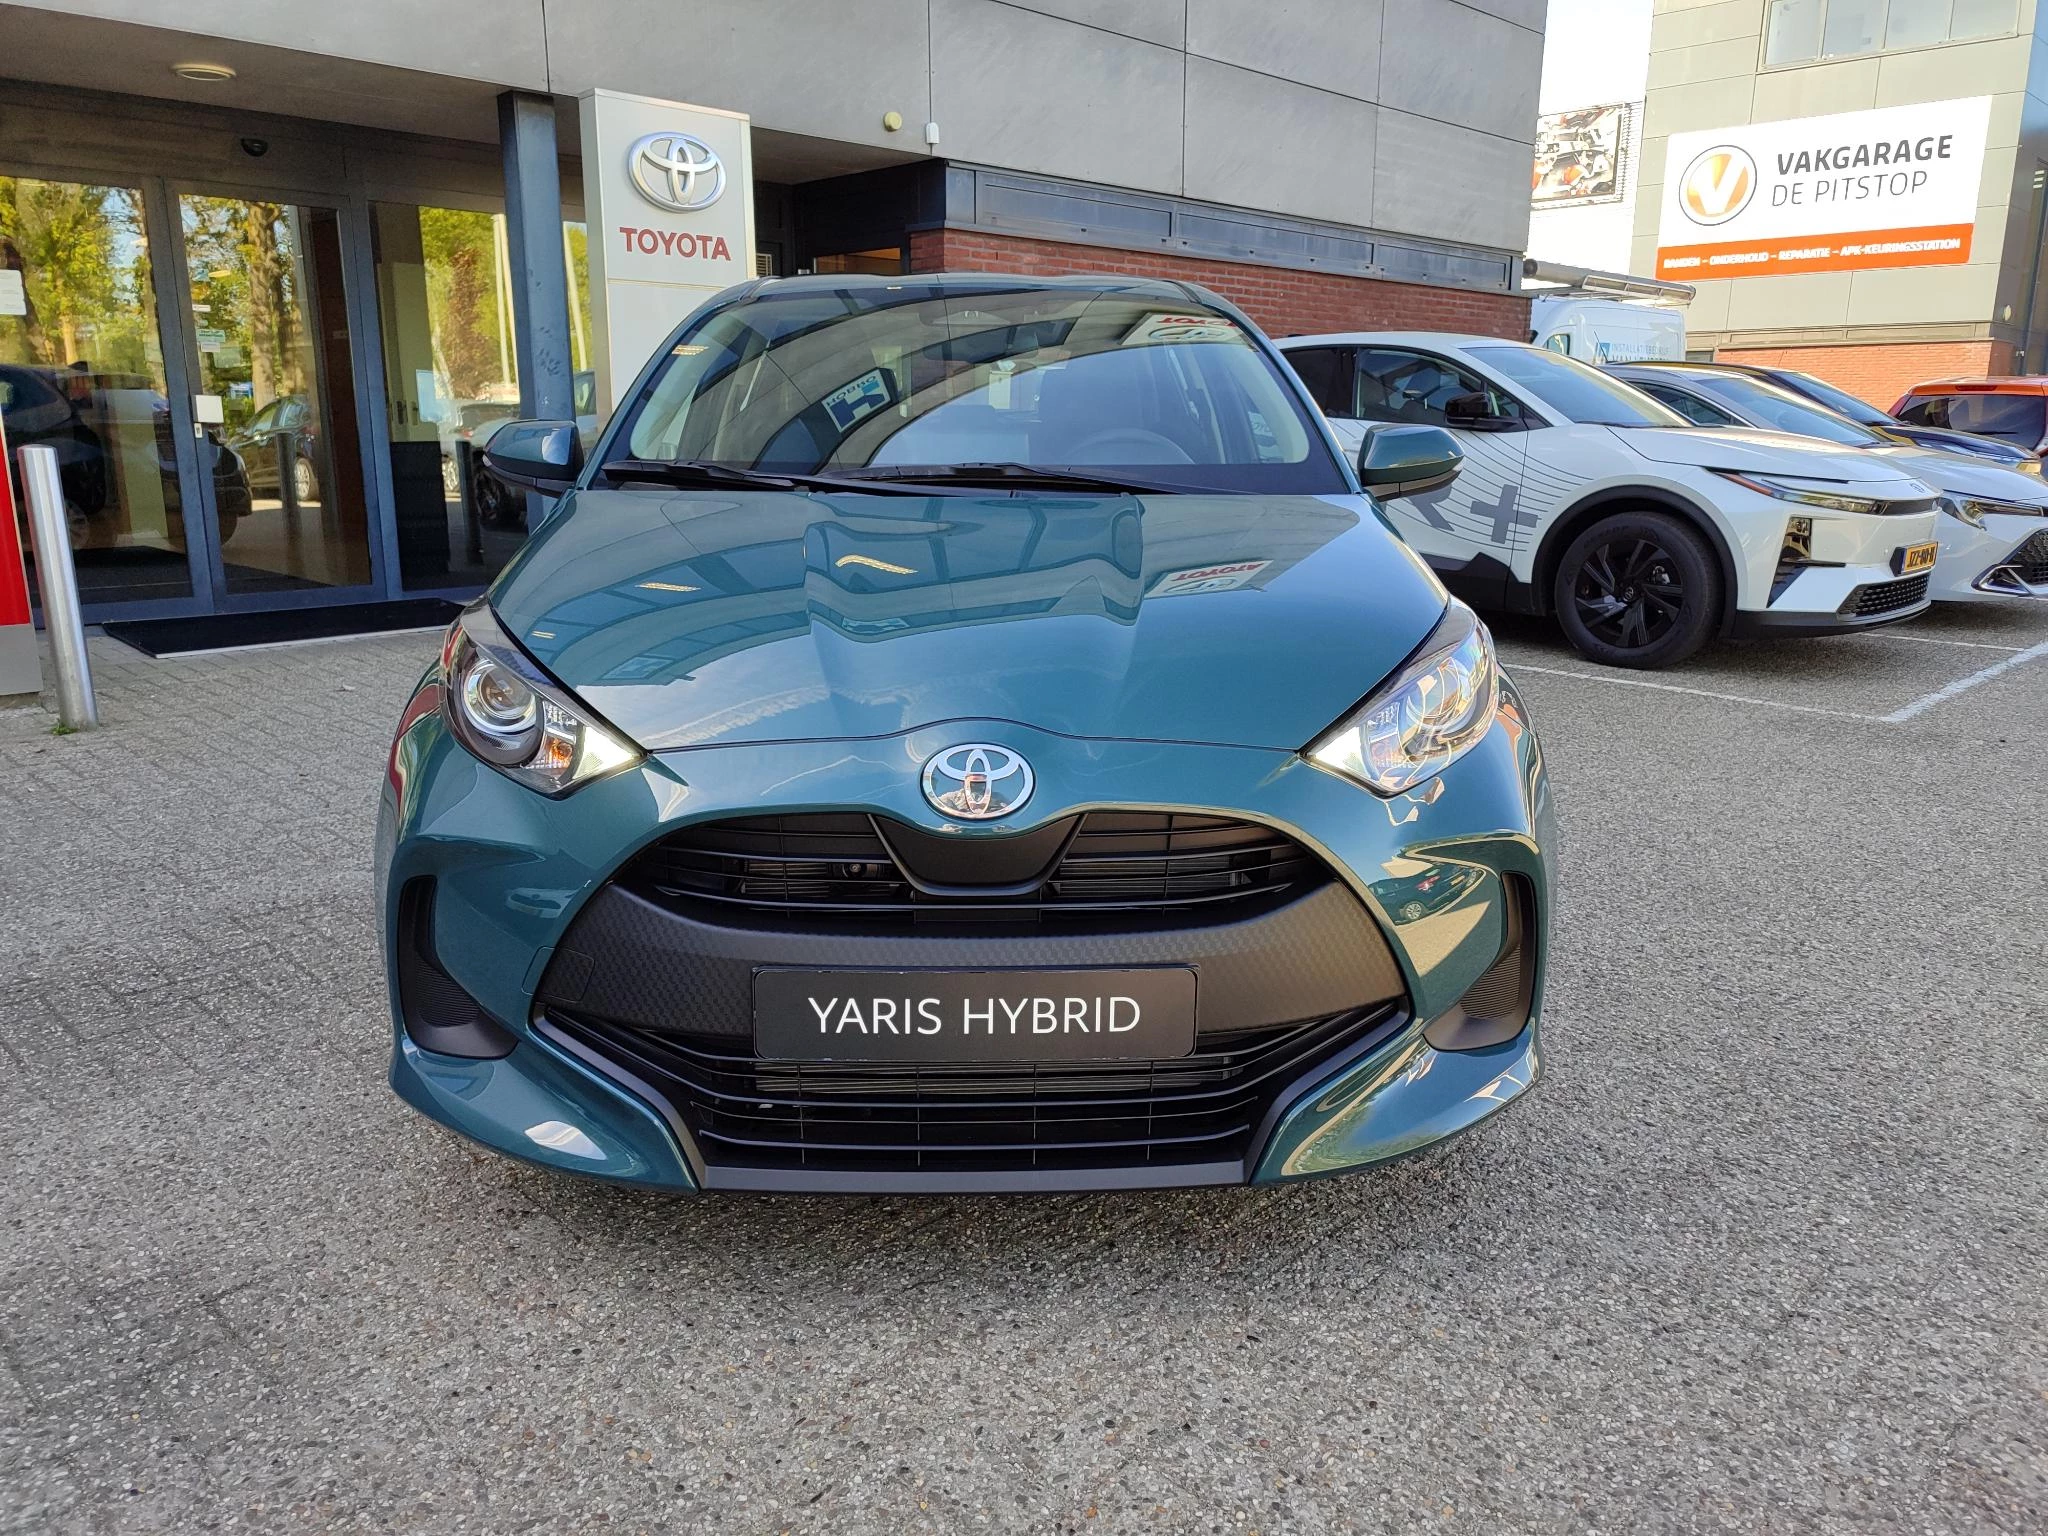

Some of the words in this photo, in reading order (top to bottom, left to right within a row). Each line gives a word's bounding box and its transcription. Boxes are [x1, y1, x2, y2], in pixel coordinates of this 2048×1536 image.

[1777, 134, 1953, 175] VAKGARAGE
[1772, 182, 1804, 207] DE
[1815, 170, 1928, 203] PITSTOP
[619, 226, 732, 261] TOYOTA
[1708, 251, 1769, 266] ONDERHOUD
[1778, 247, 1831, 261] REPARATIE
[807, 997, 942, 1035] YARIS
[963, 996, 1141, 1035] HYBRID
